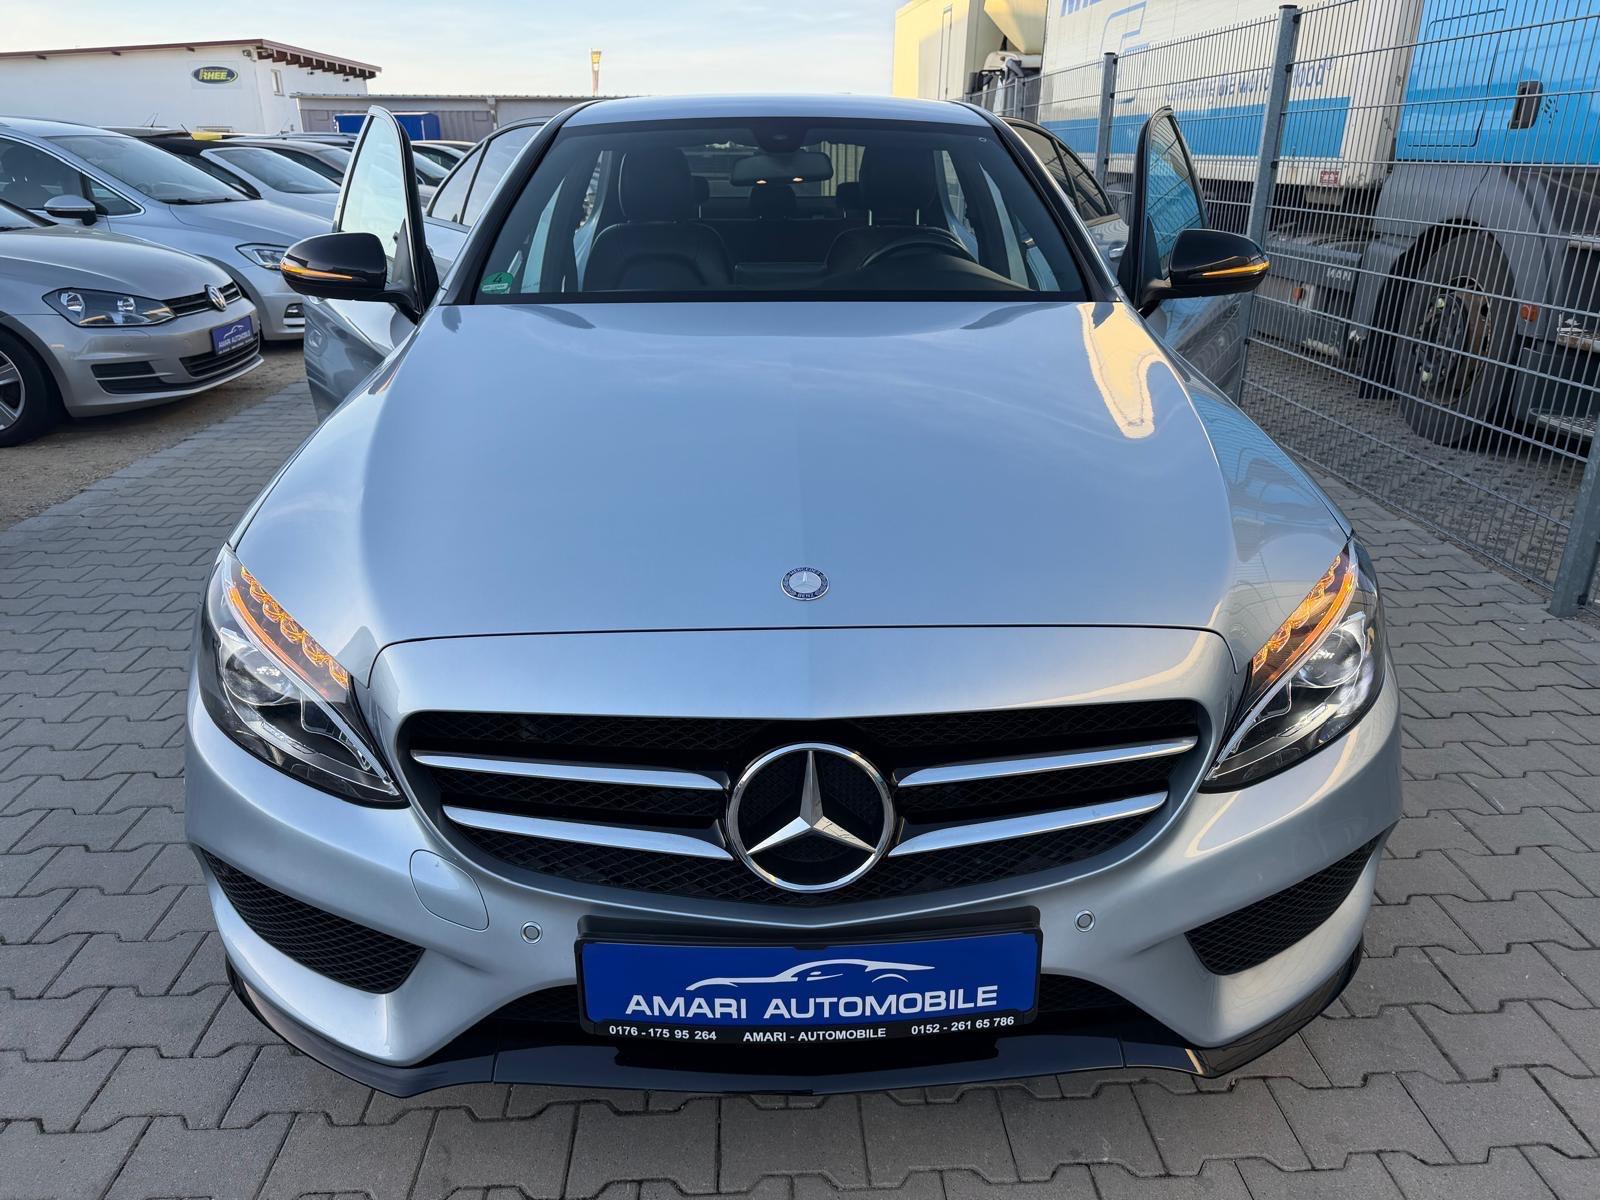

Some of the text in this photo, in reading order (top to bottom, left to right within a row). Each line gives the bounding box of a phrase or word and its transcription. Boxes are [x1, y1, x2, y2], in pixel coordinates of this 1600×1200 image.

[625, 985, 998, 1019] AMARI AUTOMOBILE
[609, 1025, 638, 1036] 0176
[648, 1028, 670, 1038] 175
[674, 1029, 690, 1039] 95
[694, 1030, 717, 1041] 264
[911, 1023, 940, 1035] 0152
[951, 1020, 972, 1032] 261
[975, 1019, 990, 1029] 65
[993, 1016, 1015, 1027] 786
[743, 1031, 786, 1042] AMARI
[798, 1028, 886, 1042] AUTOMOBILE
